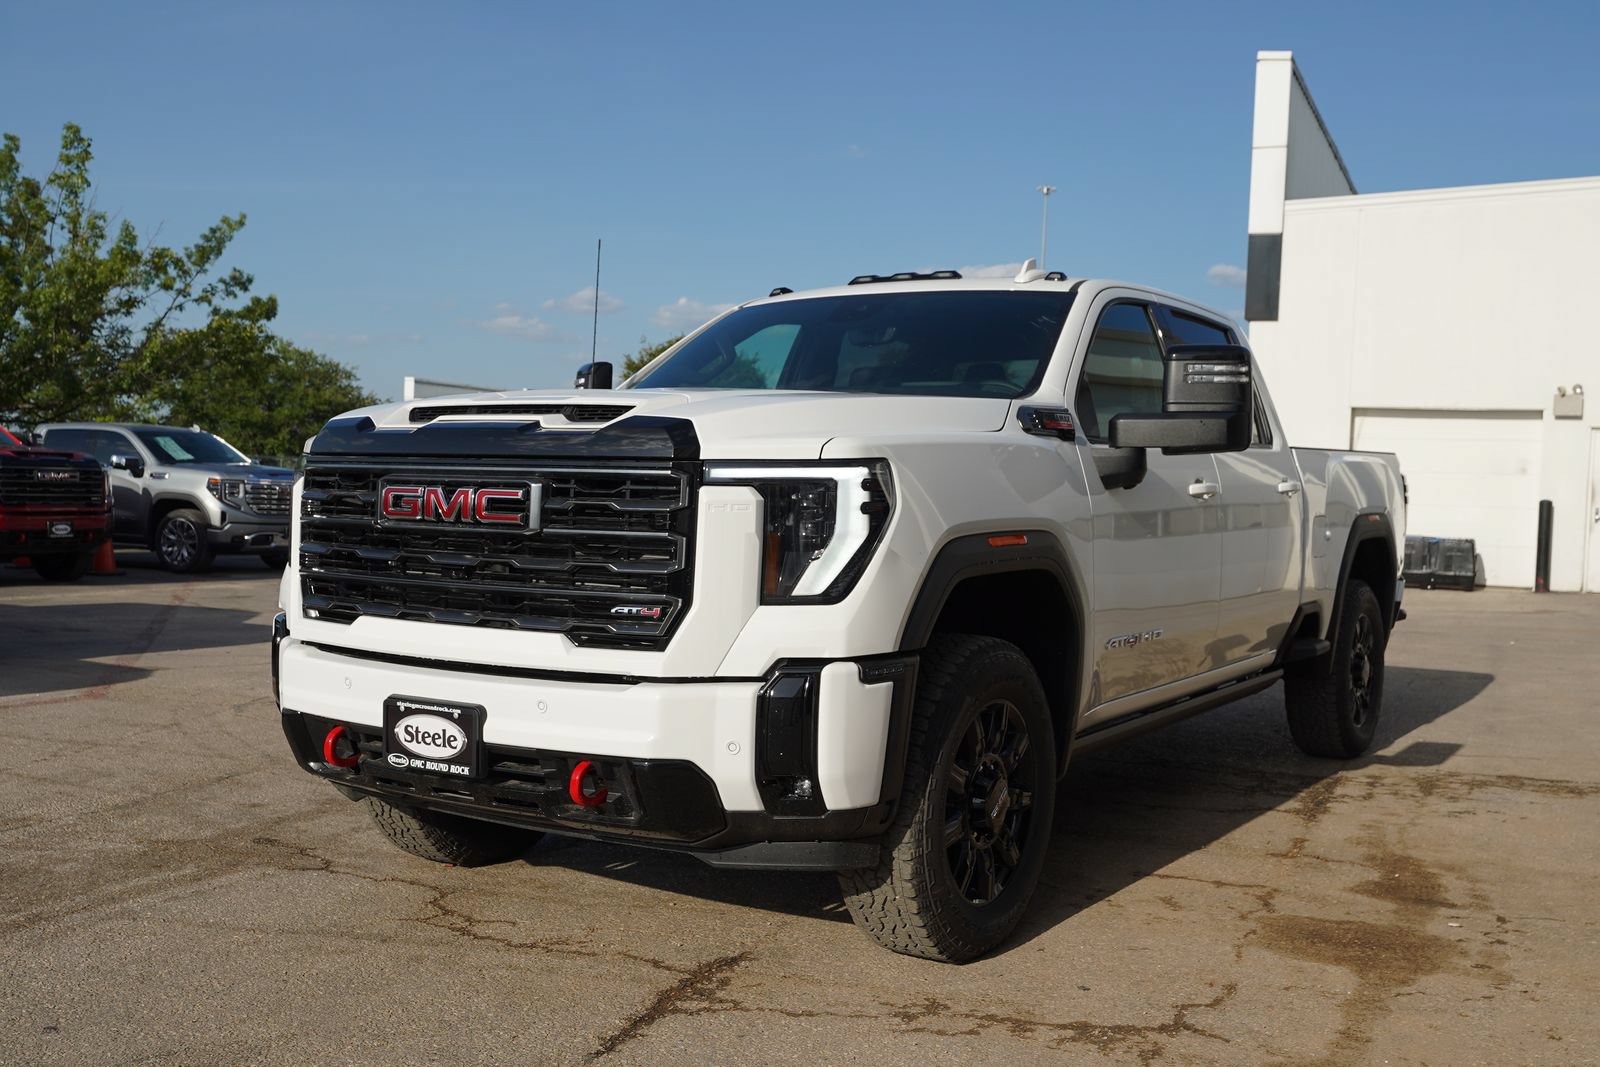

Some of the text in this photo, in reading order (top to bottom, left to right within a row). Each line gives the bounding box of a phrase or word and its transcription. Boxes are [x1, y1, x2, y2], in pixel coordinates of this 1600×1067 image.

[382, 486, 525, 525] GMC
[610, 606, 661, 618] AT4
[403, 724, 458, 750] Steele
[390, 756, 470, 775] Steele GMC ROUND ROCK
